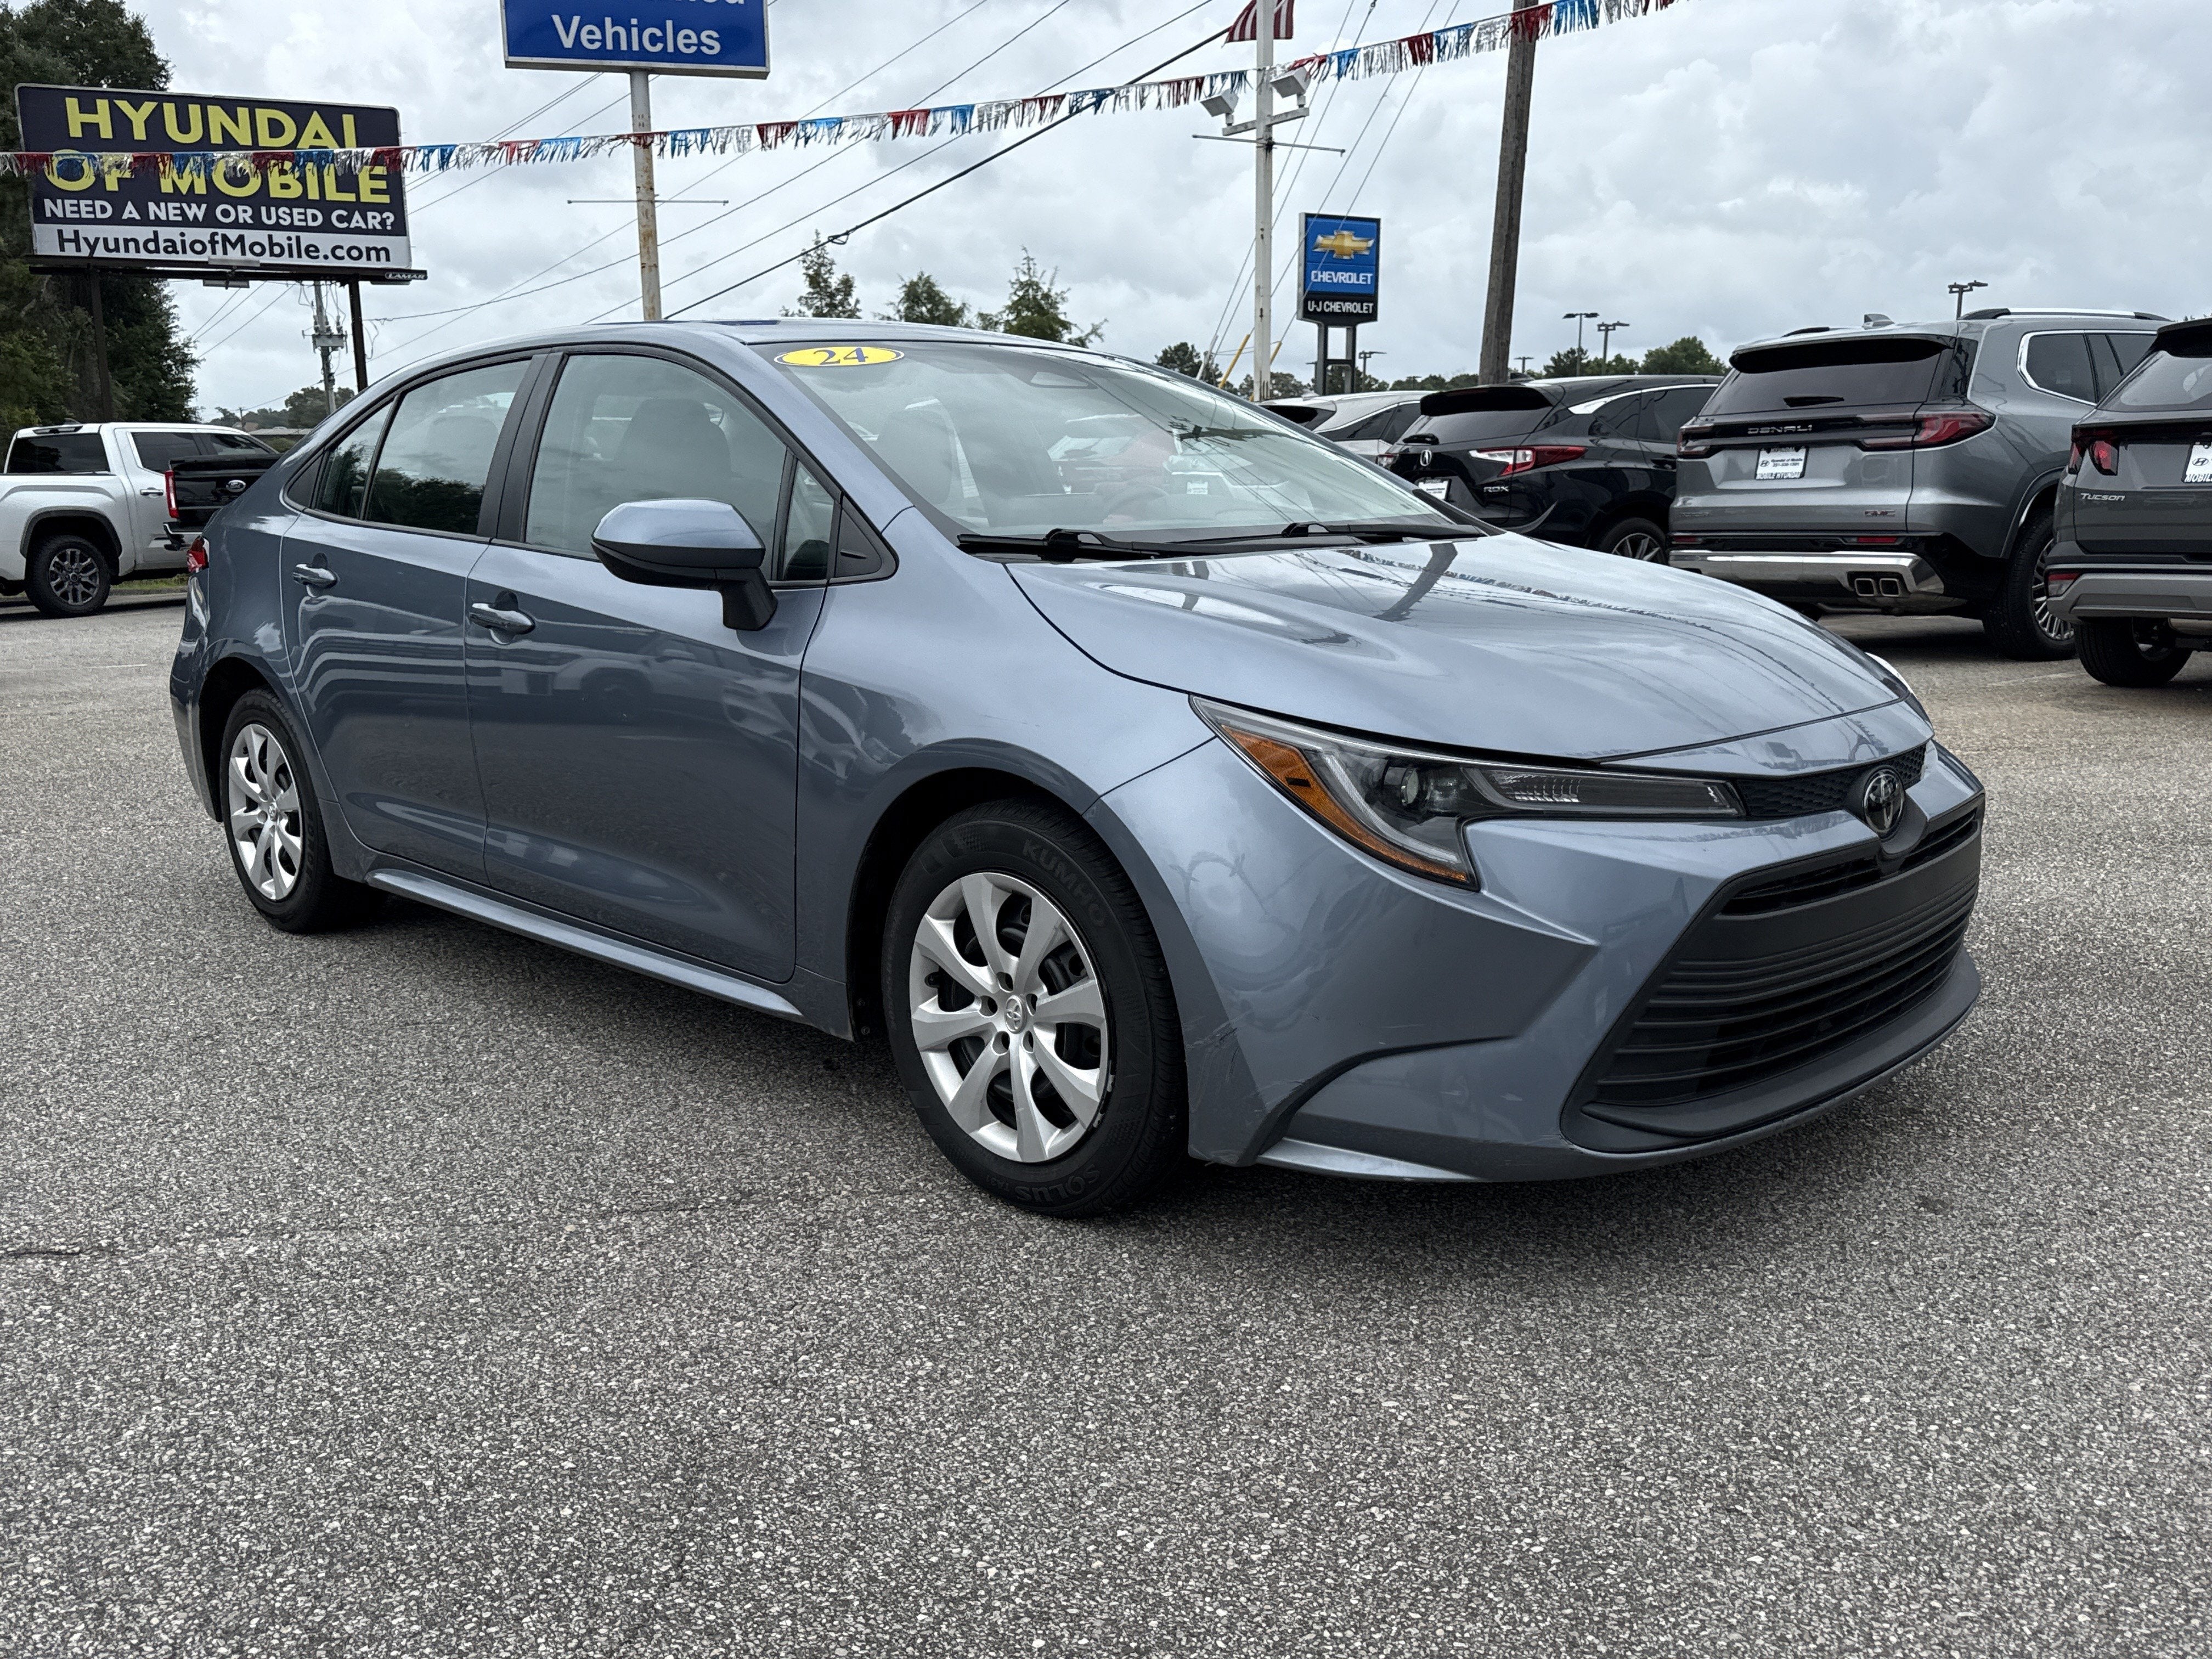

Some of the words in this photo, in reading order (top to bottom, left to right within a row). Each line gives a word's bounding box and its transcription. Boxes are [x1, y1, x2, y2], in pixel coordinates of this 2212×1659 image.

[551, 14, 721, 55] Vehicles
[65, 97, 357, 149] HYUNDAI
[43, 149, 133, 191] OF
[158, 155, 391, 204] MOBILE
[43, 198, 113, 219] NEED
[121, 200, 141, 220] A
[147, 201, 207, 222] NEW
[215, 204, 253, 224] OR
[260, 206, 323, 226] USED
[331, 209, 394, 230] CAR?
[57, 228, 391, 262] HyundaiofMobile.com
[1311, 270, 1373, 285] CHEVROLET
[1323, 301, 1374, 313] CHEVROLET
[813, 347, 868, 365] 24
[1747, 424, 1813, 435] DENALI
[2184, 473, 2212, 483] MOBIL
[2080, 493, 2126, 501] Tucson
[1023, 838, 1107, 927] KUMHO
[1015, 1163, 1101, 1202] SOLUS
